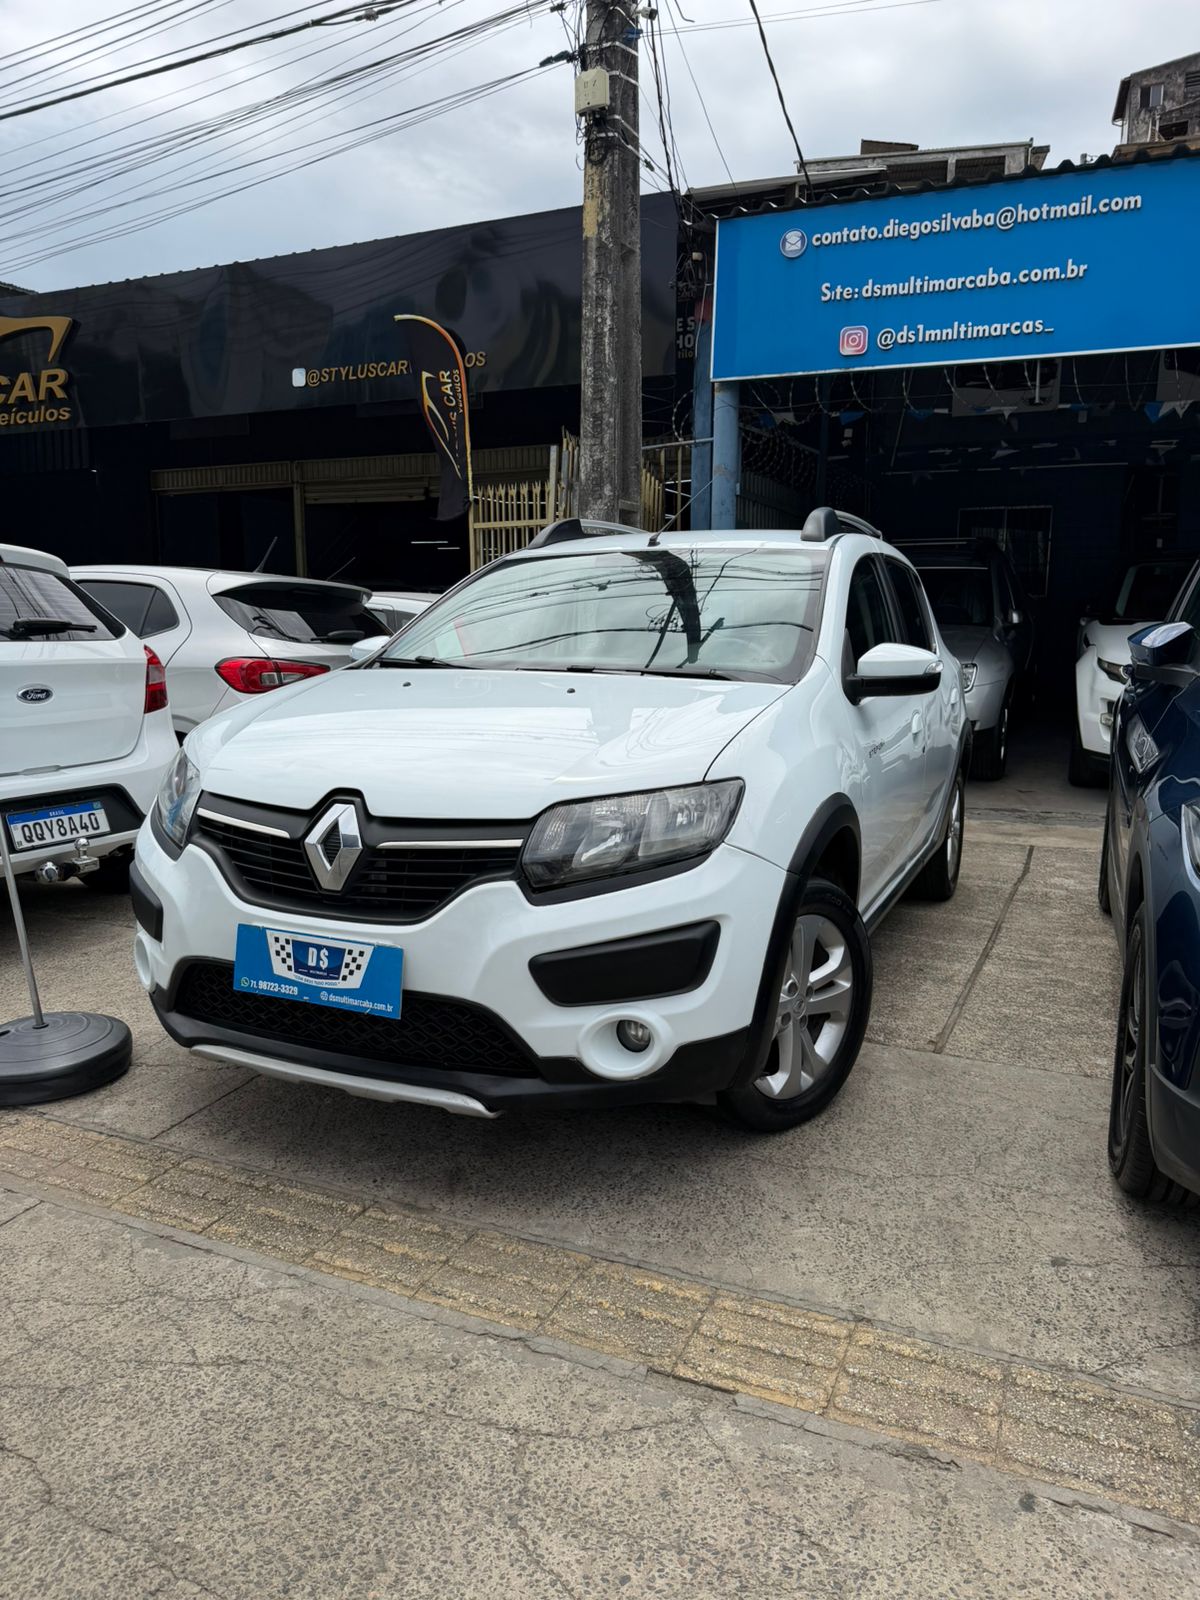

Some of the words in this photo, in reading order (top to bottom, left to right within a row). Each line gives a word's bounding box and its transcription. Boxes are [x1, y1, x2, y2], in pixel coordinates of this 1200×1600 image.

[812, 194, 1142, 246] contato.diegosilvaba@hotmail.com
[862, 258, 1088, 298] dsmultimarcaba.com.br
[307, 358, 412, 387] @STYLUSCAR
[439, 370, 456, 407] CAR
[21, 812, 100, 844] QQY8A40
[258, 980, 298, 996] 98723-3329
